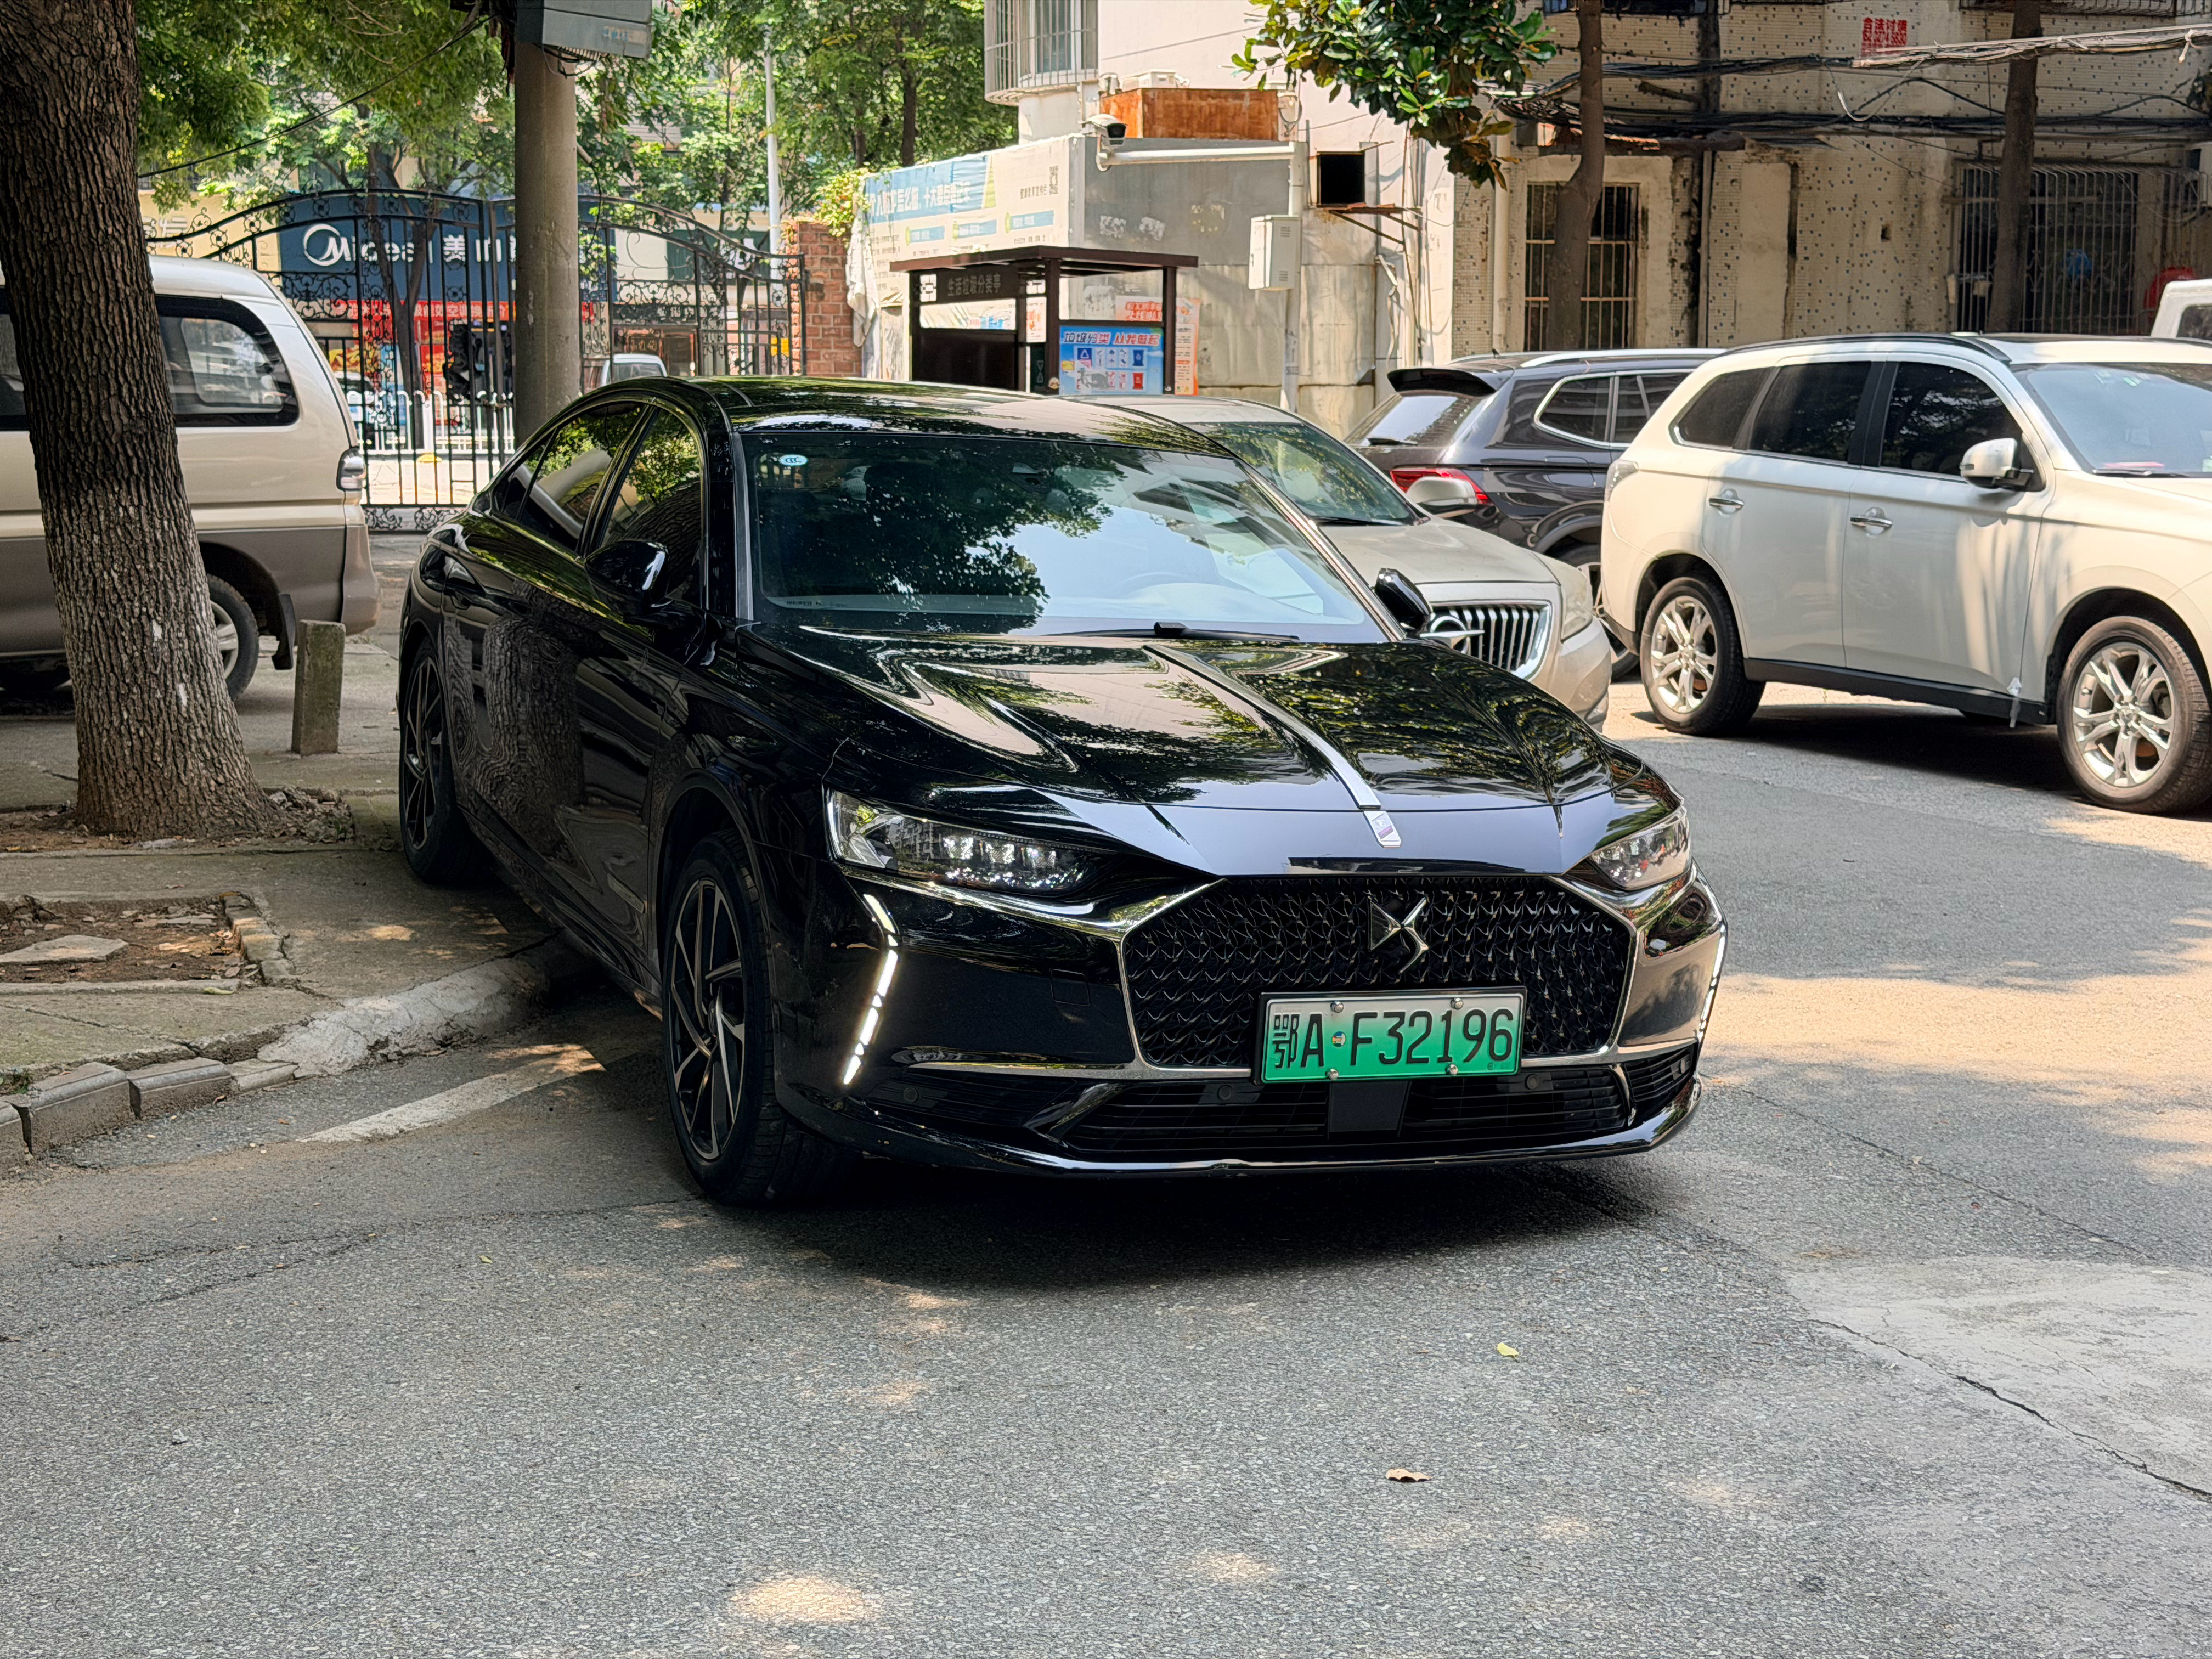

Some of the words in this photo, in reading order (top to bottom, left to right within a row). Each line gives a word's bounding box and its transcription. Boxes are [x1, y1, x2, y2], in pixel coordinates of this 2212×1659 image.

[1064, 332, 1111, 345] 垃圾分类
[1113, 332, 1160, 346] 从我做起
[1272, 1013, 1325, 1069] 鄂A
[1350, 1008, 1514, 1066] F32196
